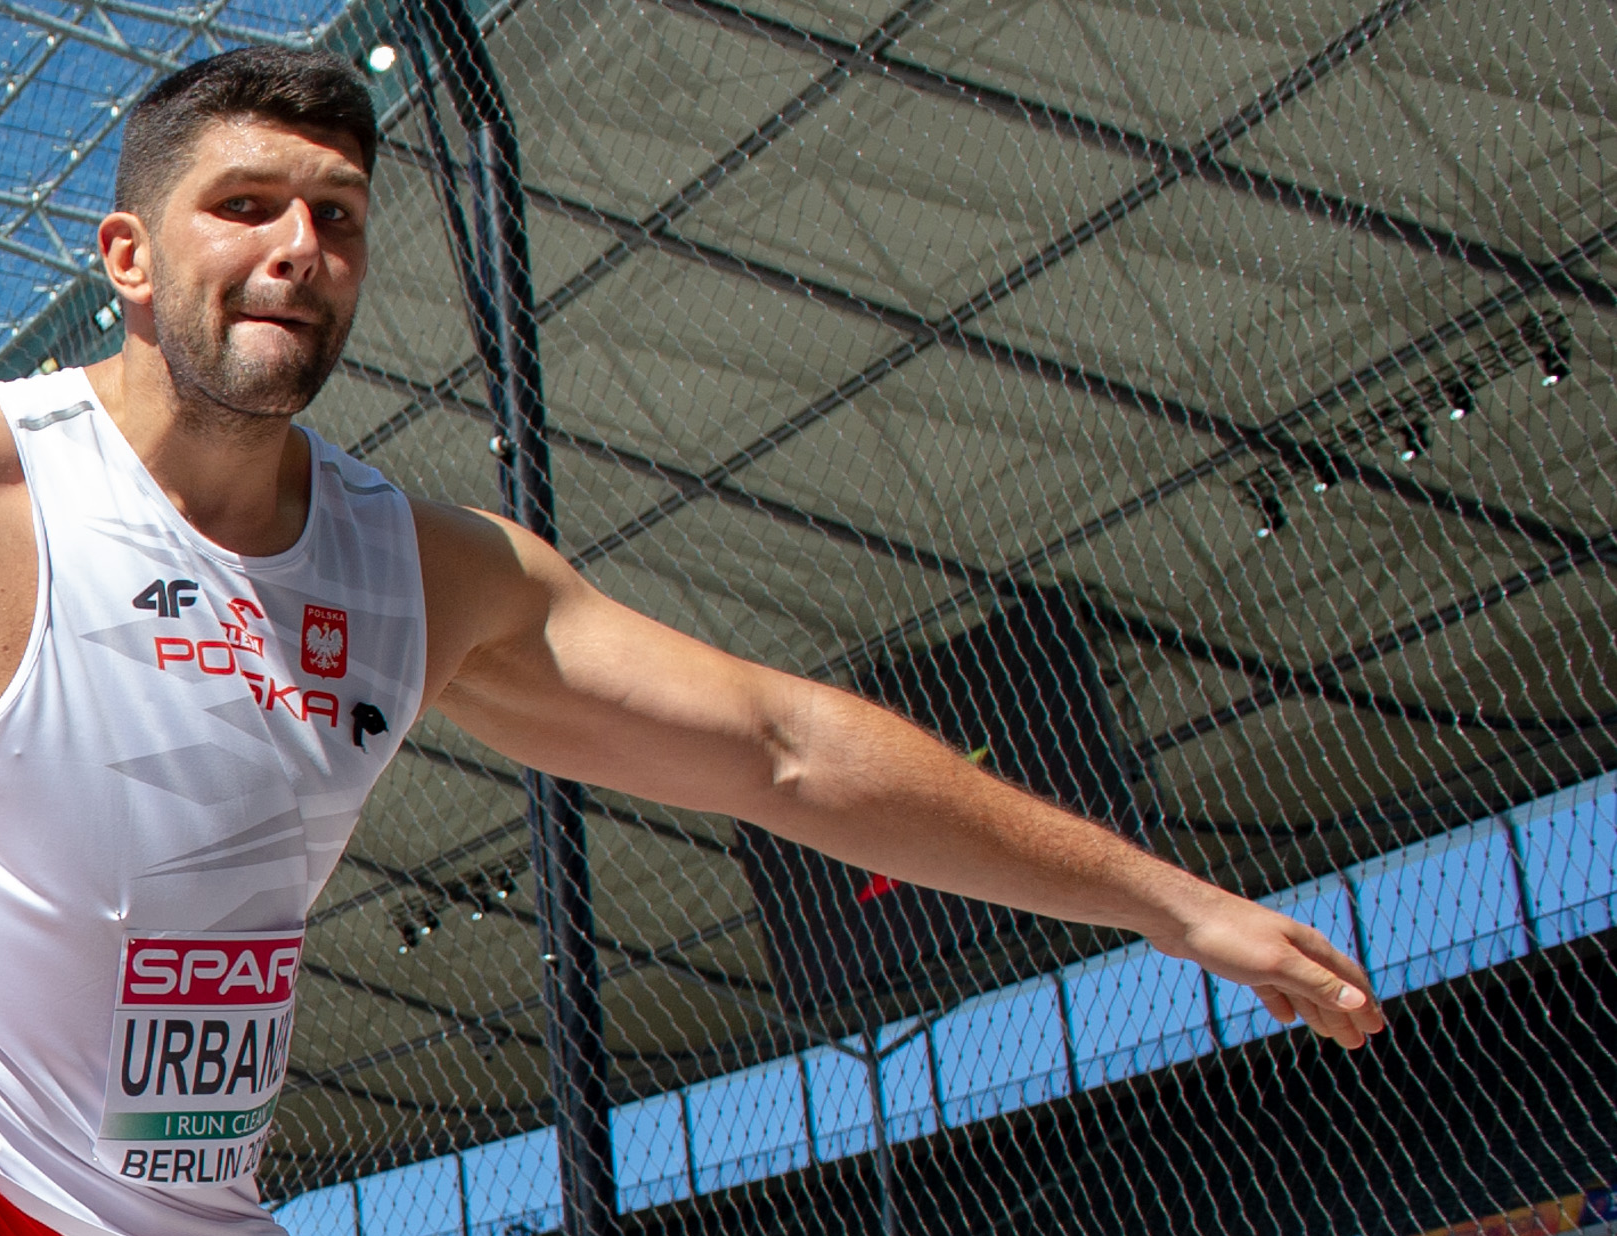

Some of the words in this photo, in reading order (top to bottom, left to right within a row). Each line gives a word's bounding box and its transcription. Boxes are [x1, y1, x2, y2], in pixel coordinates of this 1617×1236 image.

[132, 579, 199, 618] 4F
[308, 607, 345, 622] POLSKA
[154, 636, 340, 728] POSKA
[130, 947, 299, 995] SPAR
[165, 1116, 172, 1136] I
[177, 1115, 226, 1136] RUN
[120, 1145, 244, 1183] BERLIN
